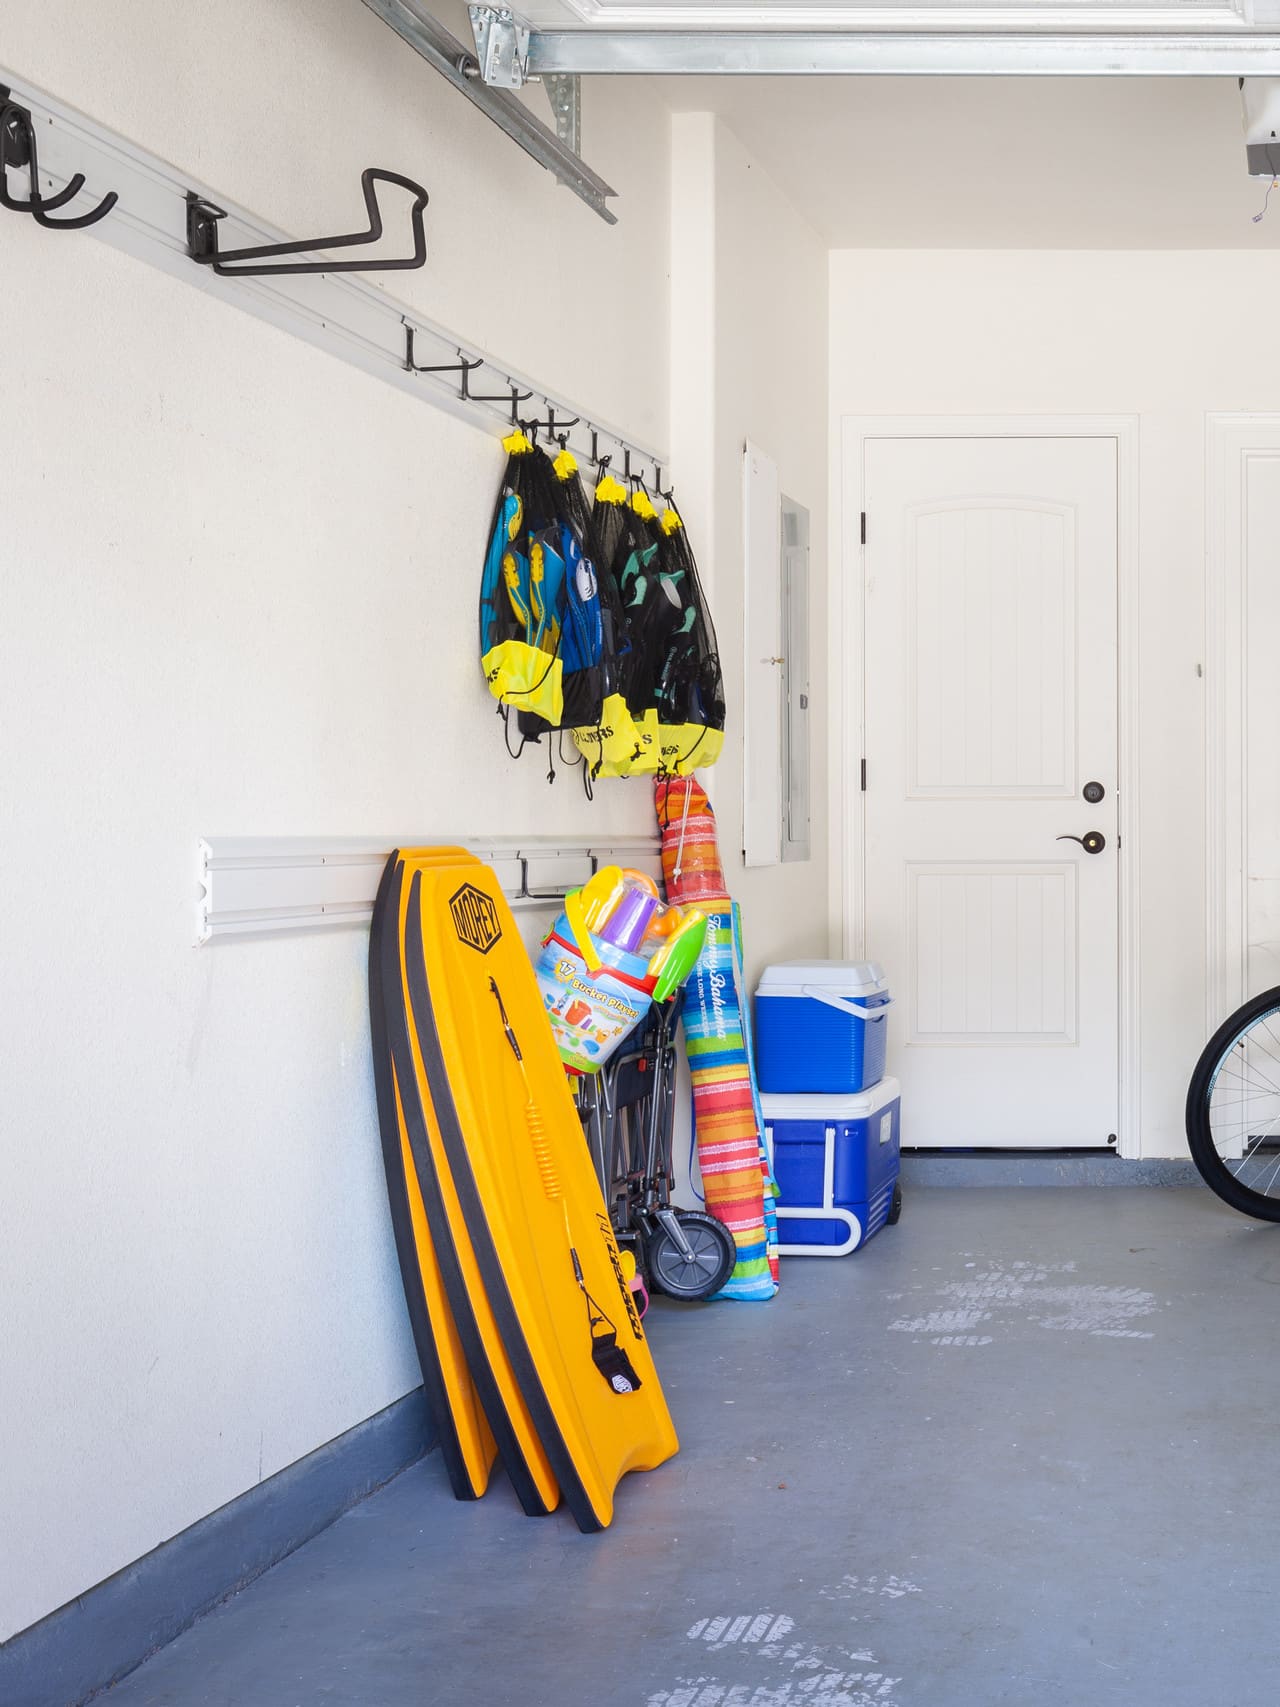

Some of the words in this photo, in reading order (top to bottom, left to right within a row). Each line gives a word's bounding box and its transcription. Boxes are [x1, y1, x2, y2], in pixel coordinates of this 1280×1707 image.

[453, 889, 497, 948] MOREY
[560, 960, 576, 976] 17
[572, 979, 607, 1002] Bucket
[697, 978, 705, 999] LONG
[710, 973, 727, 1040] Bahama
